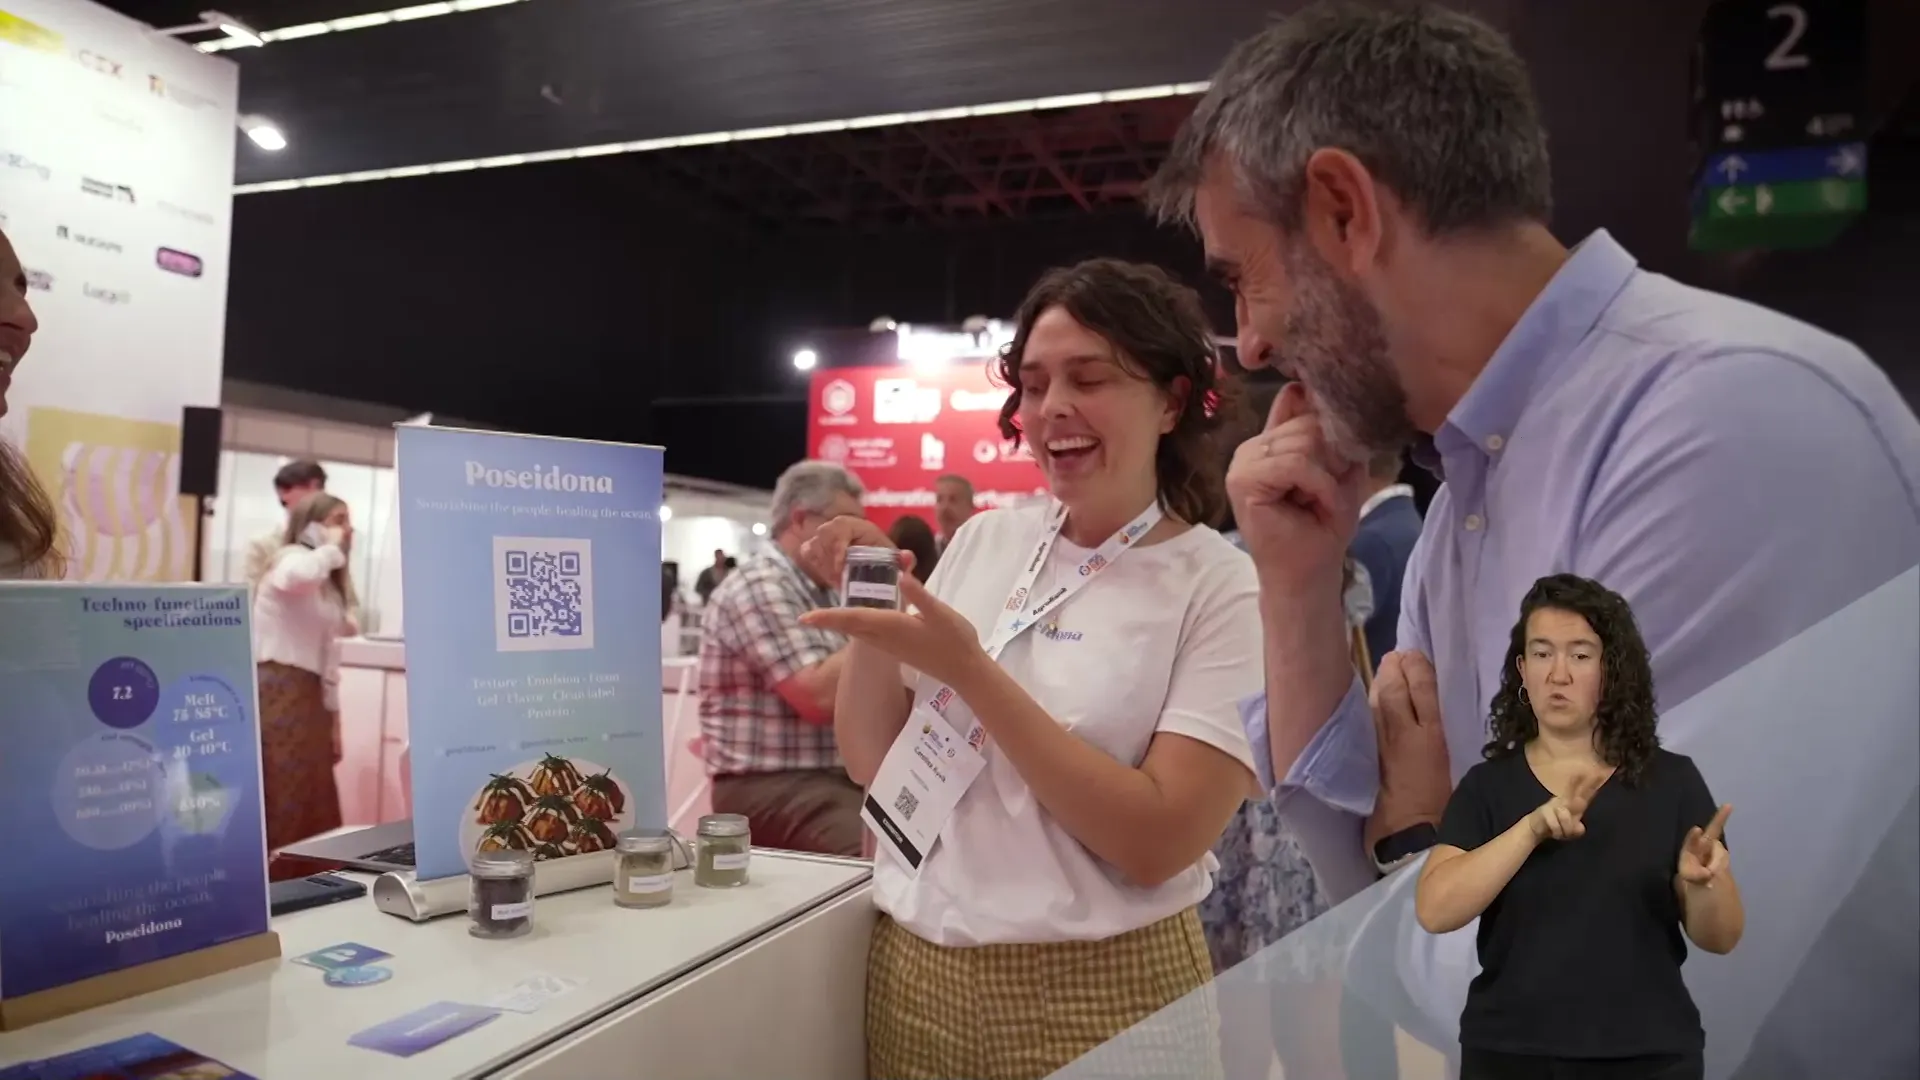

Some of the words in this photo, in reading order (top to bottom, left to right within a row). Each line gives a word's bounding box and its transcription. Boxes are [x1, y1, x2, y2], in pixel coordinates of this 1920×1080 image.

[1764, 3, 1809, 70] 2
[465, 460, 613, 494] Poseidona
[112, 685, 134, 700] 7.2
[105, 917, 183, 944] Poseidona
